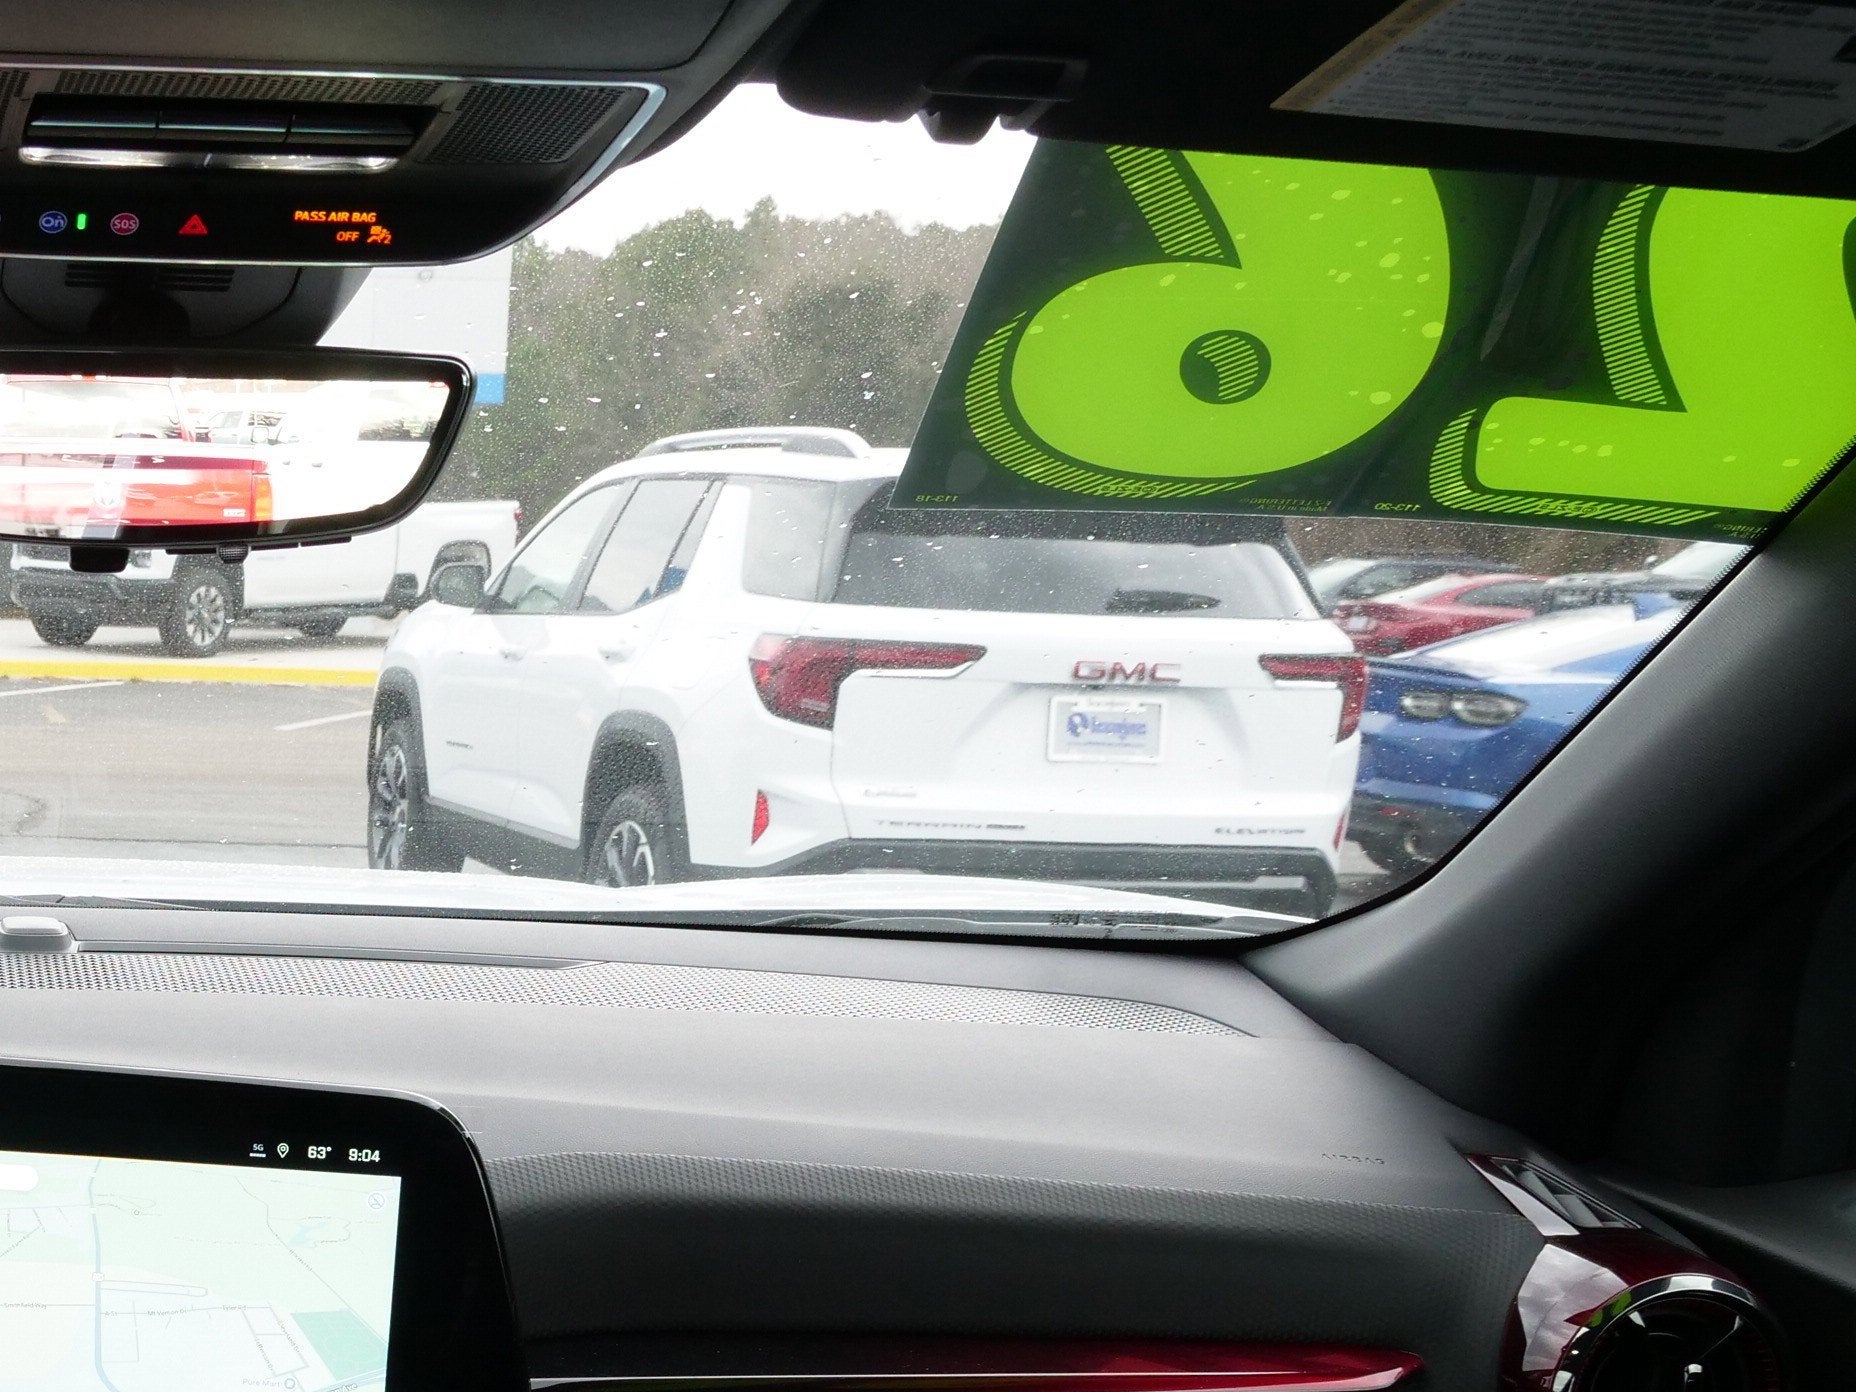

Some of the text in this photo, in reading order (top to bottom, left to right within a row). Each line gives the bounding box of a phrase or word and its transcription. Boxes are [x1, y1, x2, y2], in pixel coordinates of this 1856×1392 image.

[294, 210, 377, 223] PASS AIR BAG
[113, 218, 136, 229] SOS
[336, 231, 360, 242] OFF
[1071, 660, 1181, 683] GMC
[252, 1143, 264, 1152] 5G
[307, 1144, 332, 1161] 63°
[348, 1146, 381, 1163] 9:04
